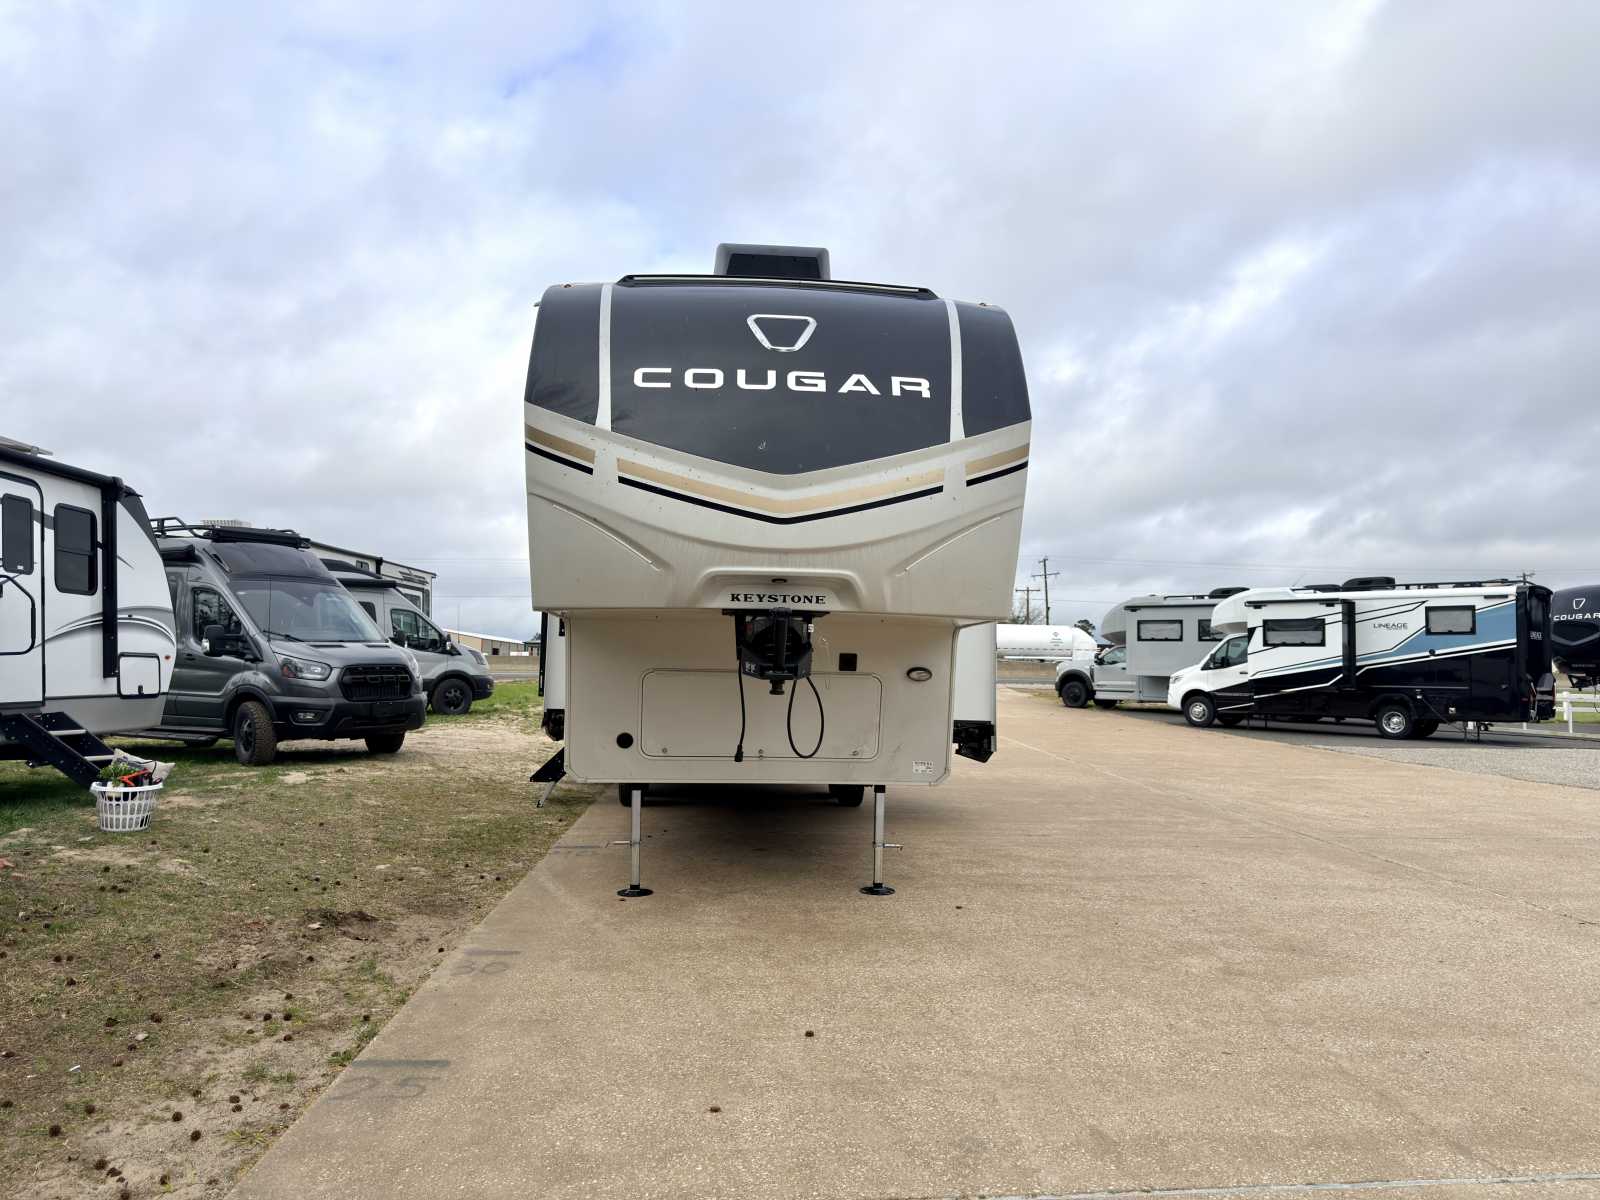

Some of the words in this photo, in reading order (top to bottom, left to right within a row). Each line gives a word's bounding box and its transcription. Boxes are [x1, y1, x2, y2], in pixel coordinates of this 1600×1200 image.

[633, 367, 931, 399] COUGAR
[730, 593, 826, 604] KEYSTONE
[1553, 612, 1600, 621] COUGAR
